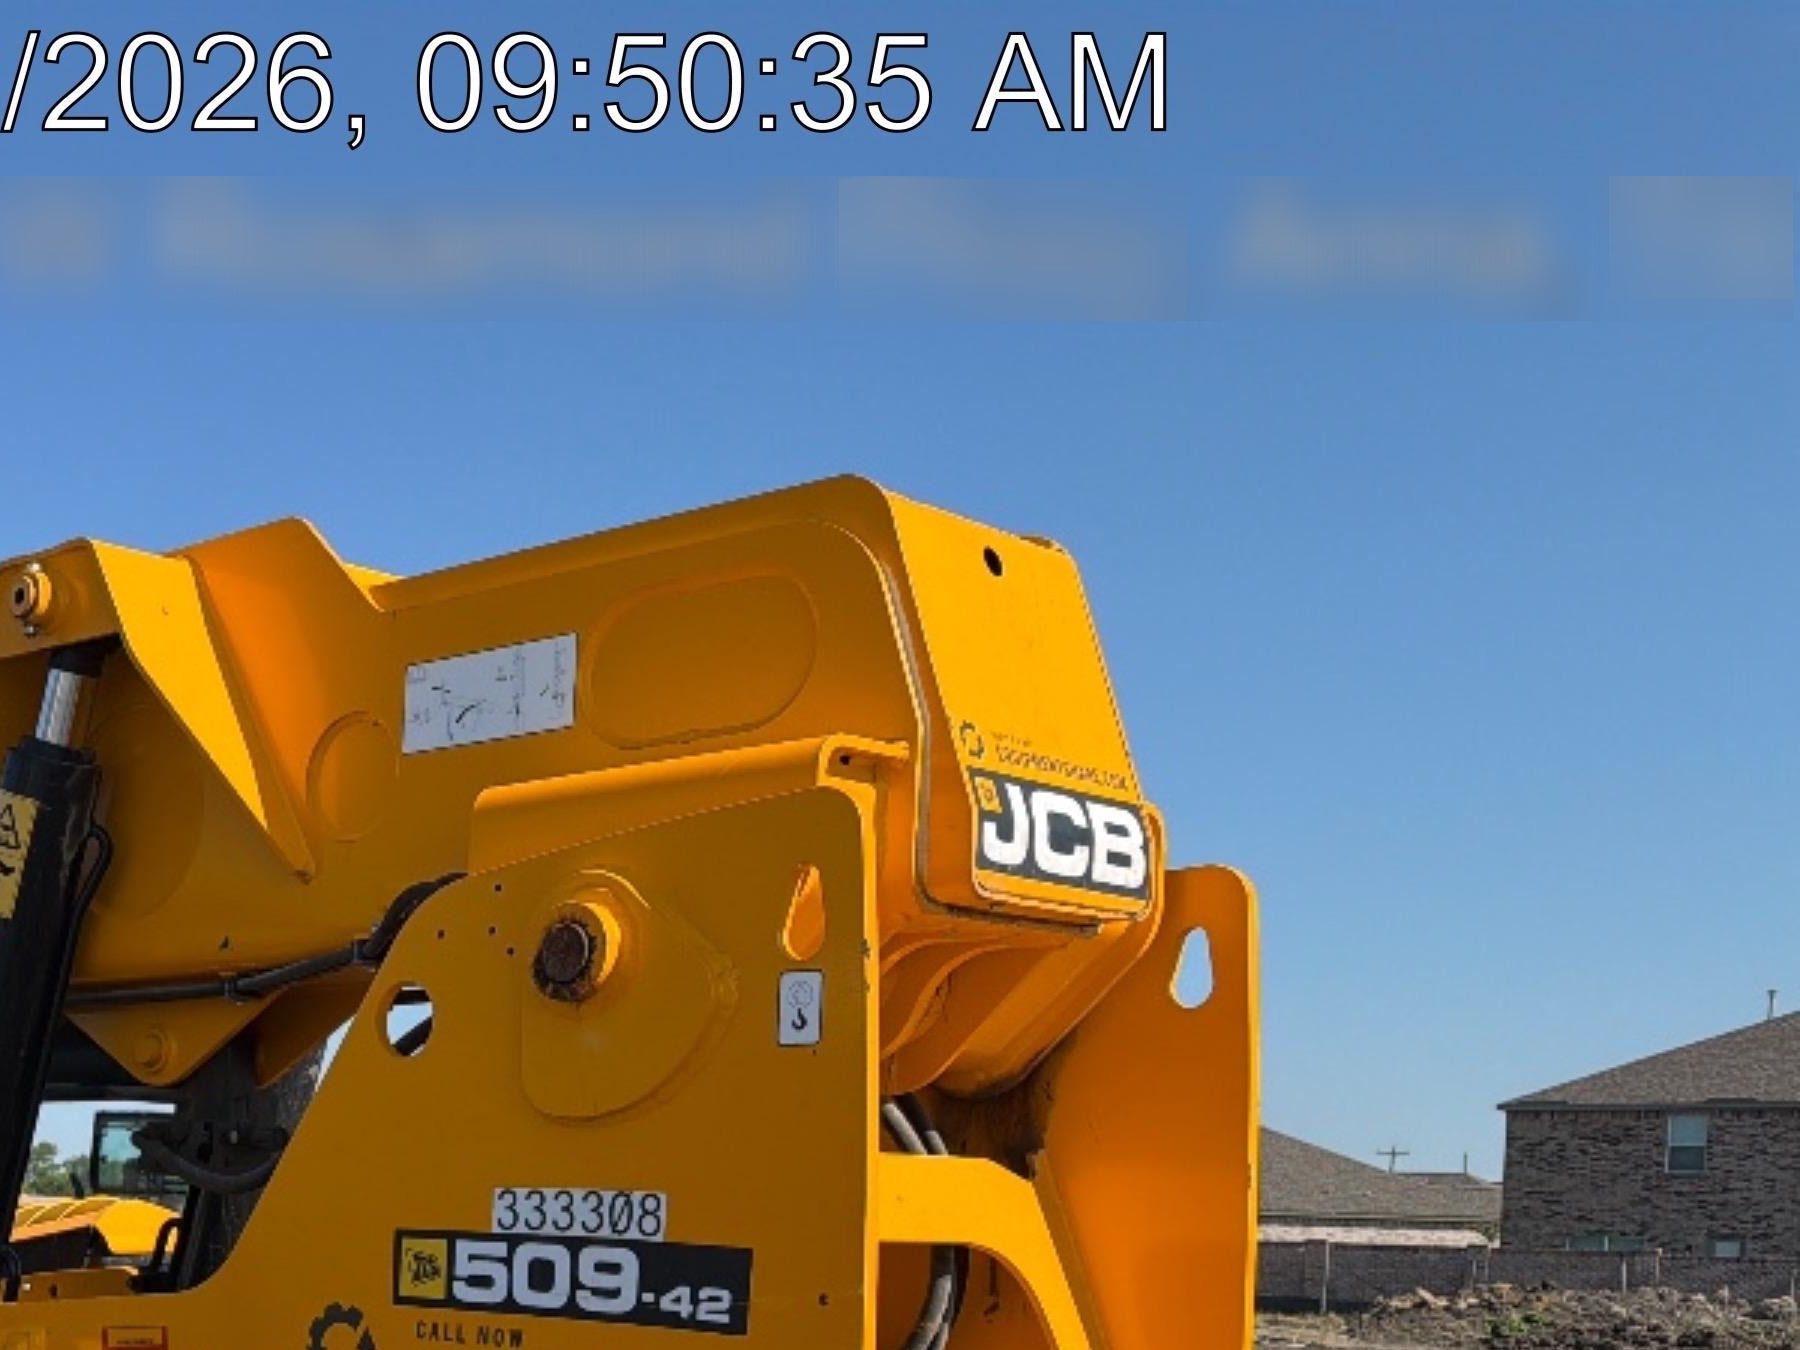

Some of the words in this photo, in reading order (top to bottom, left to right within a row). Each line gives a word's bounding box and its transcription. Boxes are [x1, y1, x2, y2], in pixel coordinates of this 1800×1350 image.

[982, 783, 1147, 889] JCB
[497, 1188, 663, 1237] 333308
[416, 1320, 466, 1344] CALL
[477, 1327, 523, 1348] NOW
